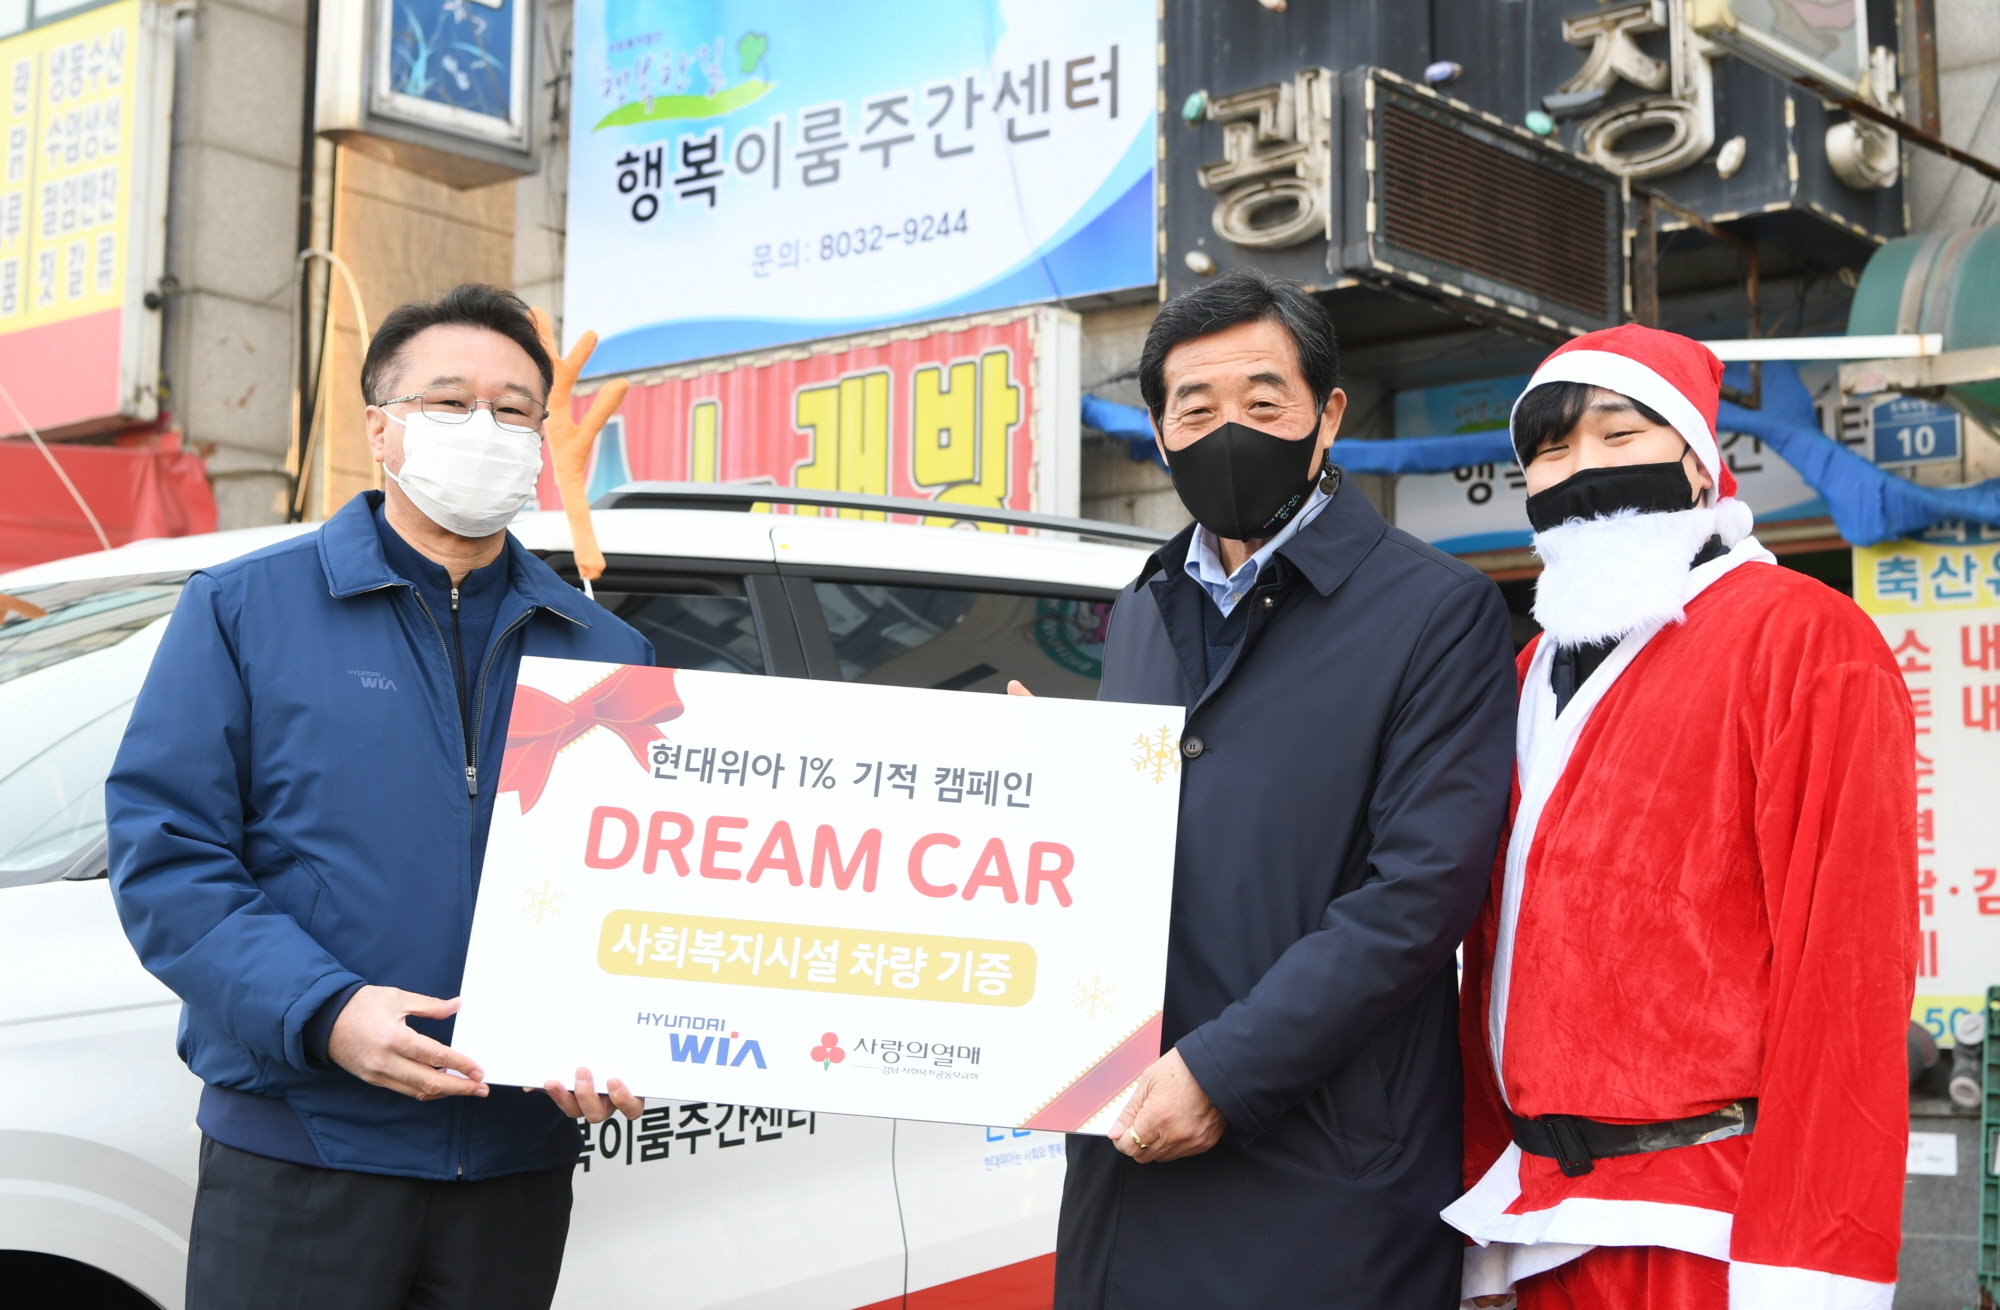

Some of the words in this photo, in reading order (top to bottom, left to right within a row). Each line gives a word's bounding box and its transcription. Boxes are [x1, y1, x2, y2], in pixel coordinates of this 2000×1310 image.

[51, 28, 124, 103] 냉동수산
[617, 44, 1120, 223] 행복이룸주간센터
[819, 208, 968, 261] 8032-9244
[1896, 424, 1936, 457] 10
[347, 669, 381, 678] HYUNDAI
[652, 743, 785, 789] 현대위아
[798, 756, 837, 790] 1%
[853, 761, 918, 800] 기적
[934, 765, 1033, 809] 캠페인
[584, 806, 883, 893] DREAM
[907, 832, 1075, 908] CAR
[611, 923, 840, 984] 사회복지시설
[849, 942, 929, 989] 차량
[937, 950, 1013, 996] 기증
[637, 1012, 726, 1032] HYUNDAI
[669, 1031, 768, 1070] WIA
[853, 1038, 981, 1068] 사랑의열매
